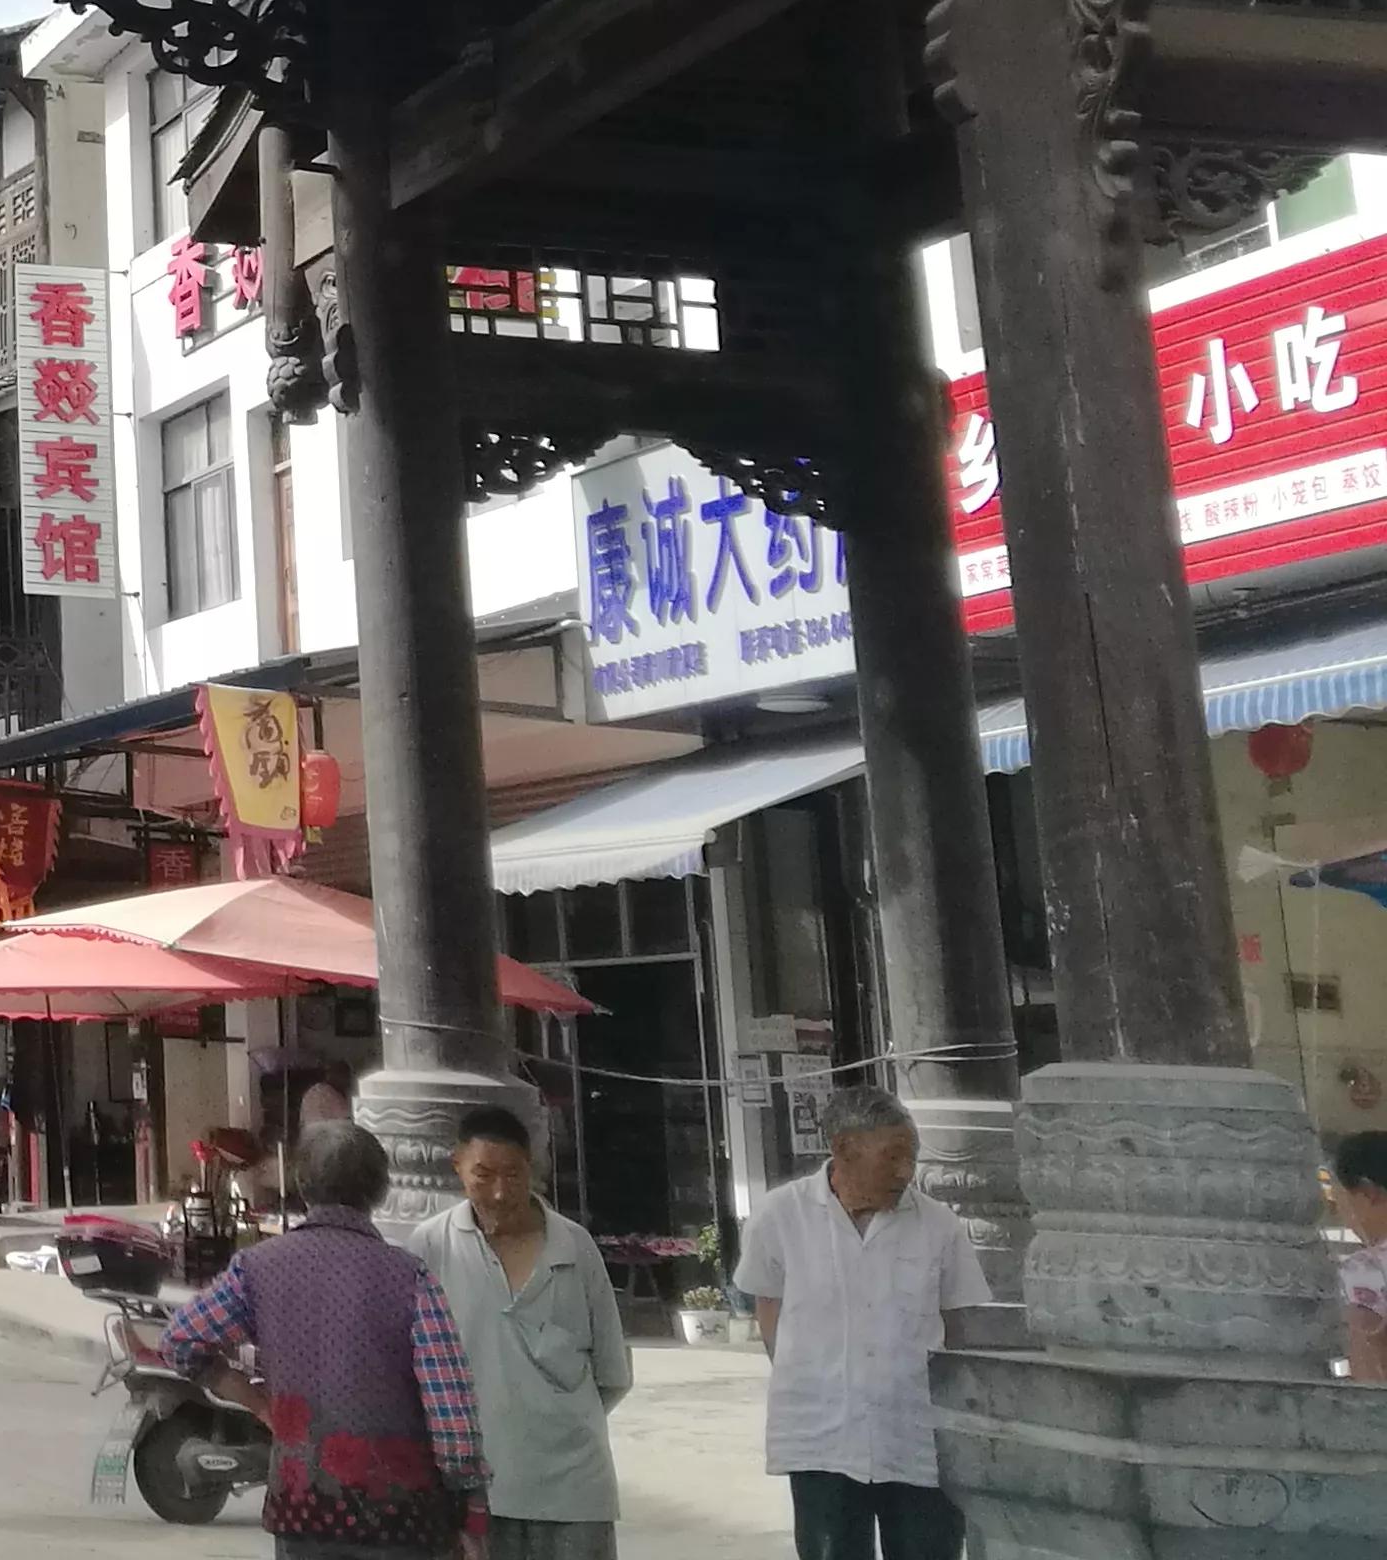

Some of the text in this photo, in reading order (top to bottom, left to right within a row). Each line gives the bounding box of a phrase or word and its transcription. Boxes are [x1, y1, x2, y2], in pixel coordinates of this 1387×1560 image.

[29, 282, 103, 583] 香燚宾馆
[1185, 306, 1359, 445] 小吃
[587, 473, 848, 644] 康诚大药
[1204, 492, 1259, 527] 酸辣粉
[1272, 475, 1329, 511] 小笼包
[1341, 462, 1383, 495] 蒸饺
